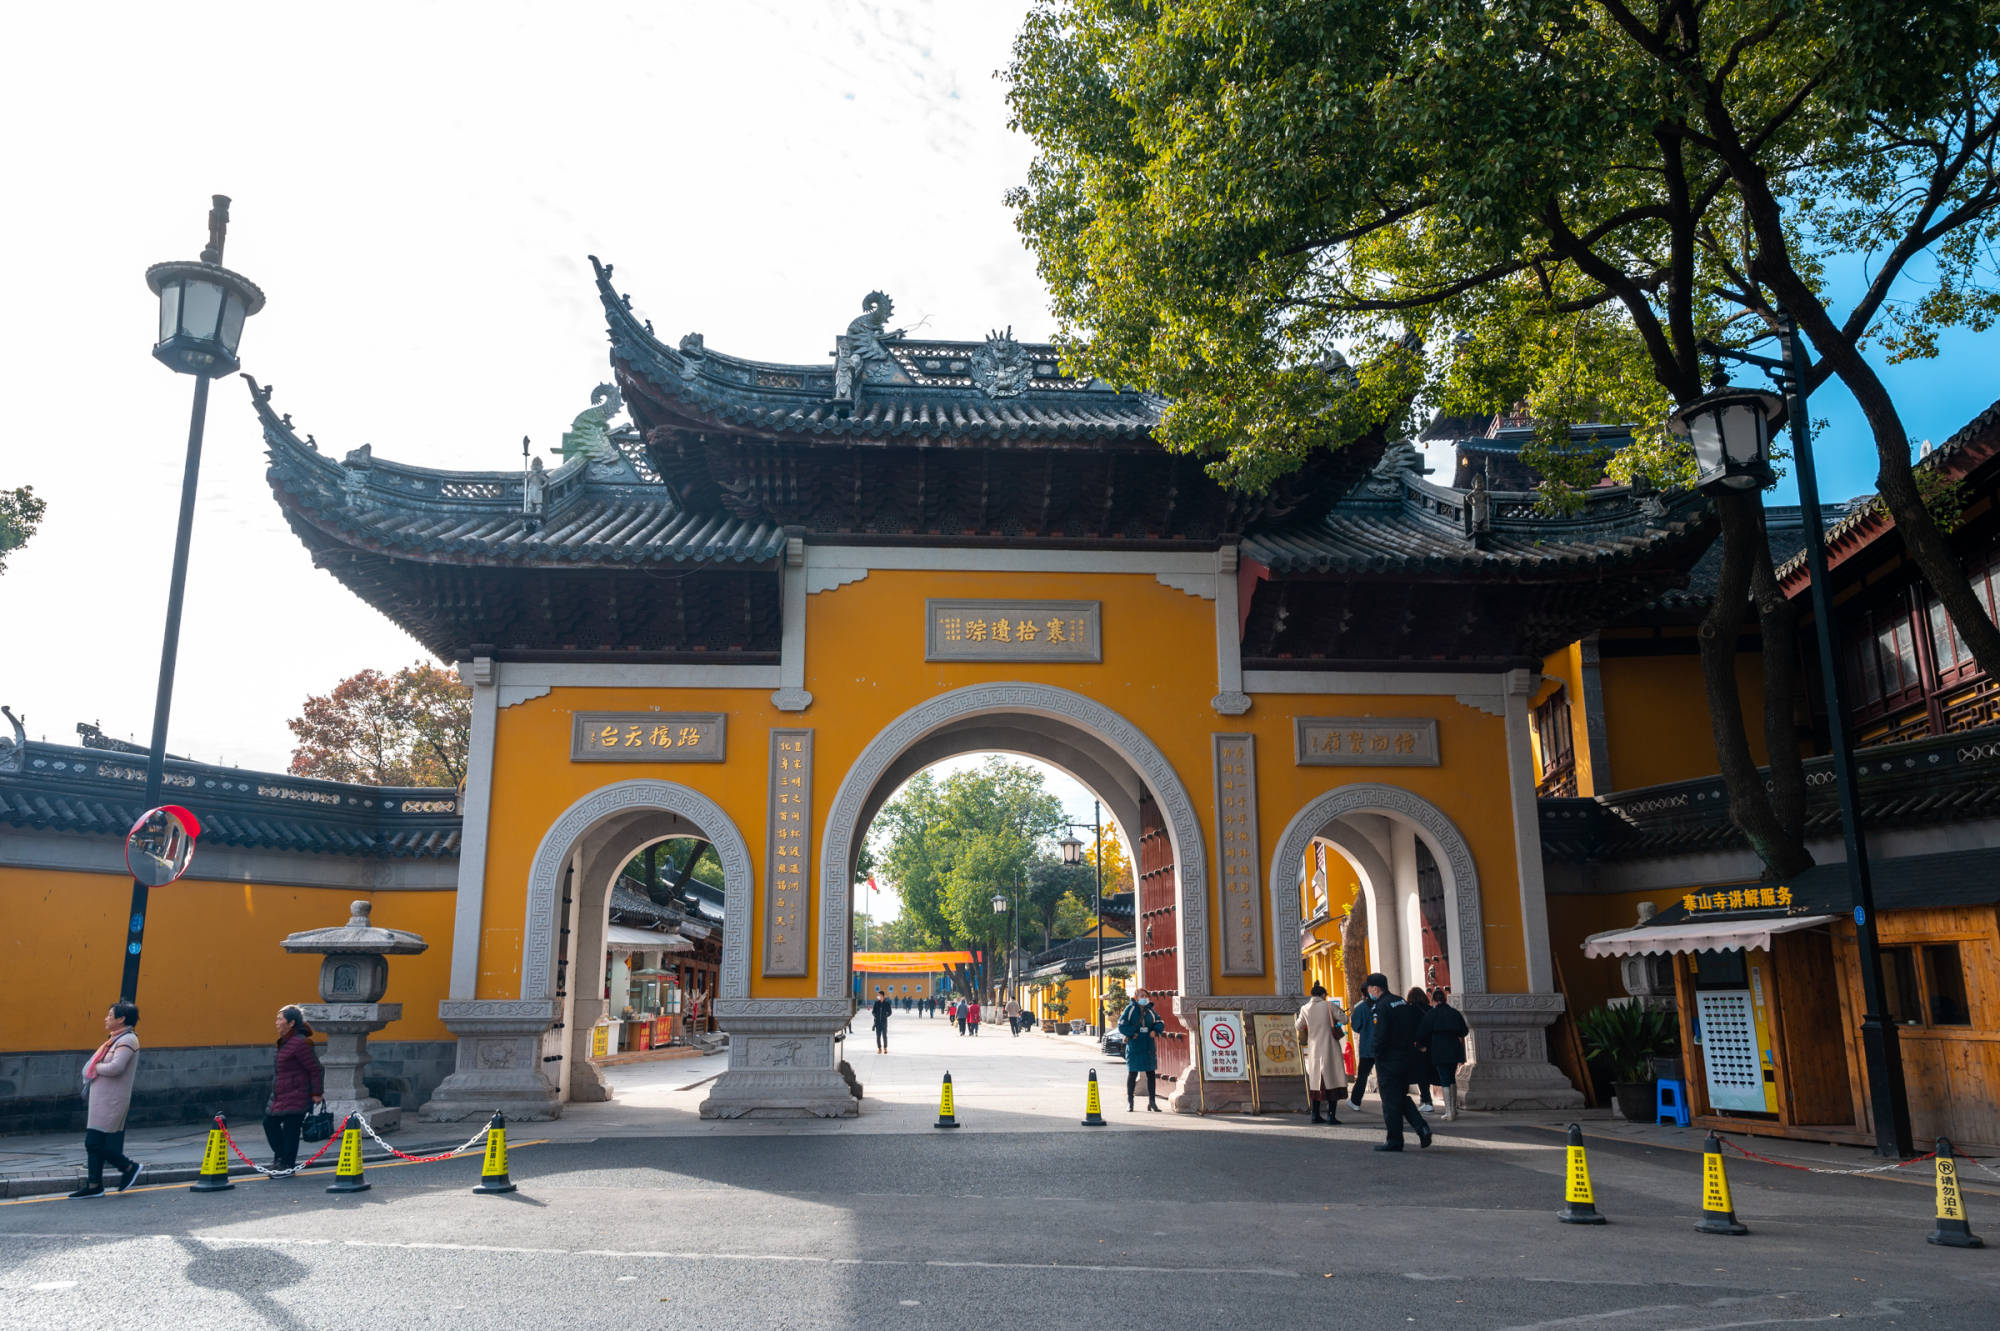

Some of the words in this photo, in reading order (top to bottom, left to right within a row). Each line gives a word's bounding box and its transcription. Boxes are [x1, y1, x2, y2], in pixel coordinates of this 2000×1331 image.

[1682, 886, 1793, 912] 寒山寺讲解服务
[1940, 1175, 1959, 1217] 请勿泊车
